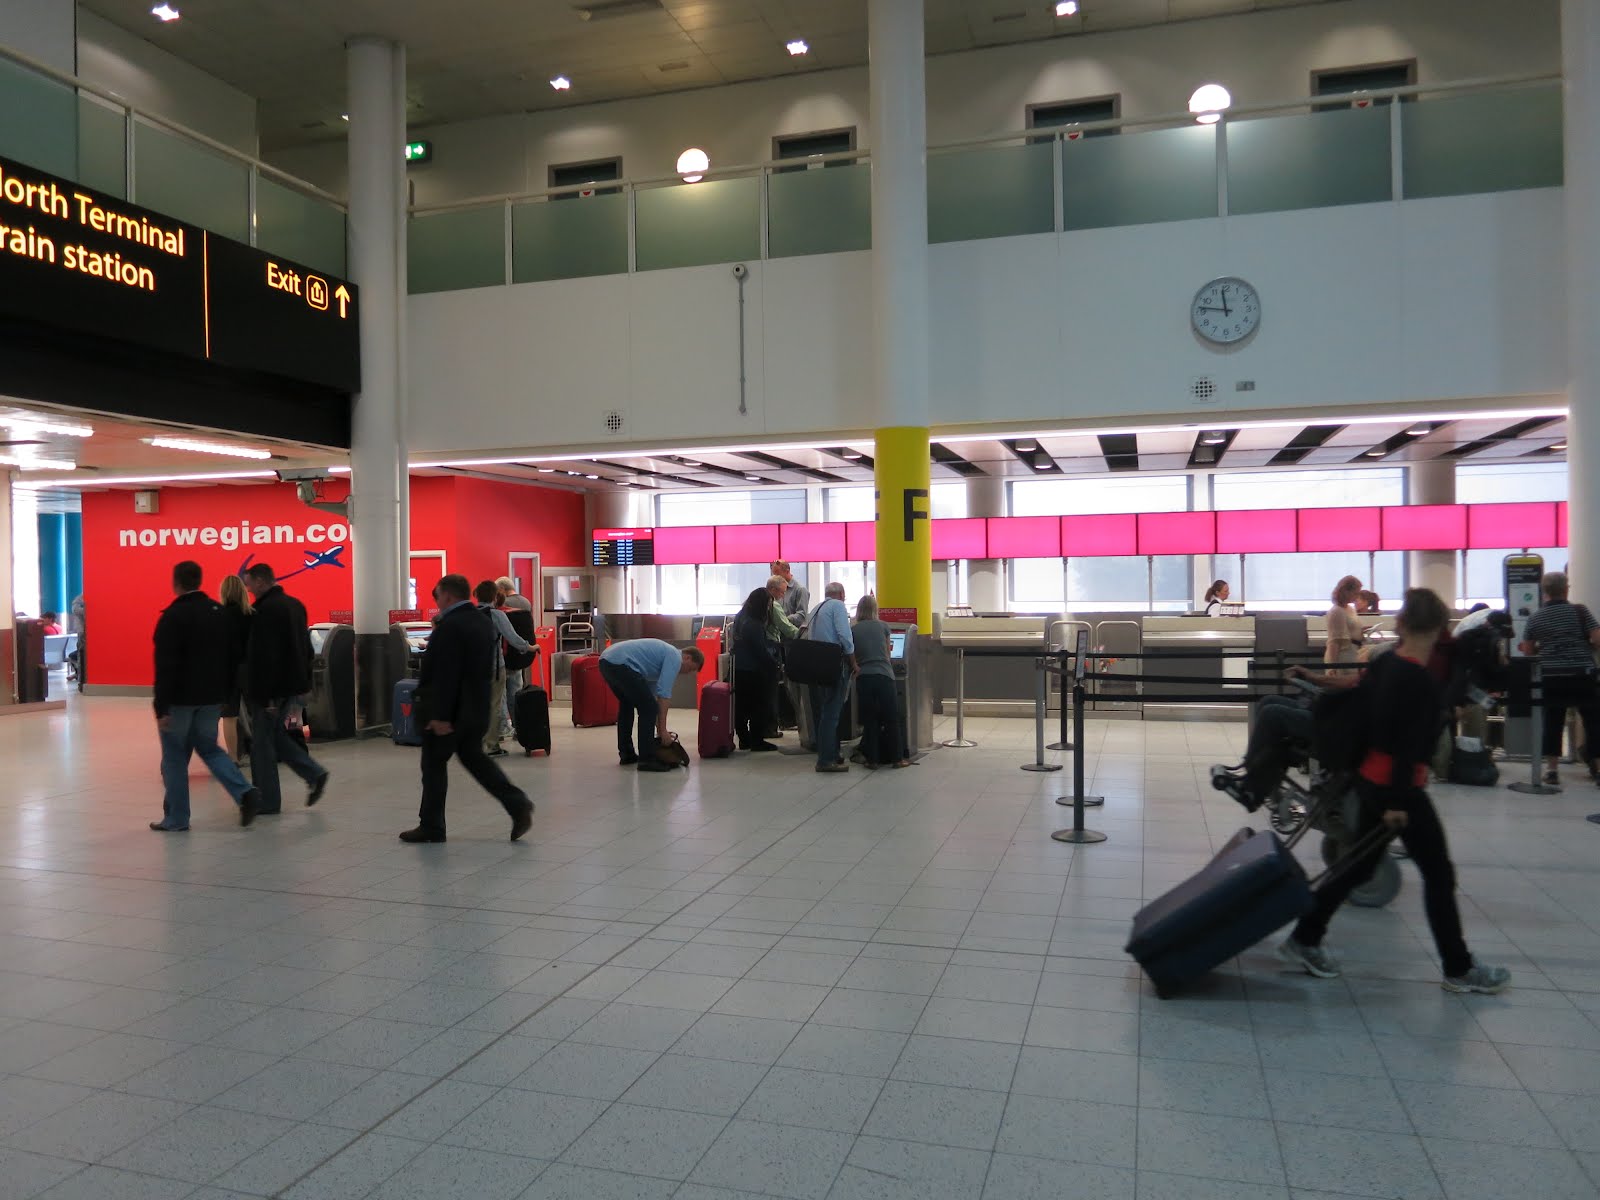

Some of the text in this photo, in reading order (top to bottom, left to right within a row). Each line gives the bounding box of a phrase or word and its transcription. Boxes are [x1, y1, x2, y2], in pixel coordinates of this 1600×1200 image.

[0, 167, 183, 256] orth Terminal
[64, 245, 154, 290] station
[268, 262, 301, 295] Exit
[120, 521, 352, 550] norwegian.co
[904, 489, 928, 542] F
